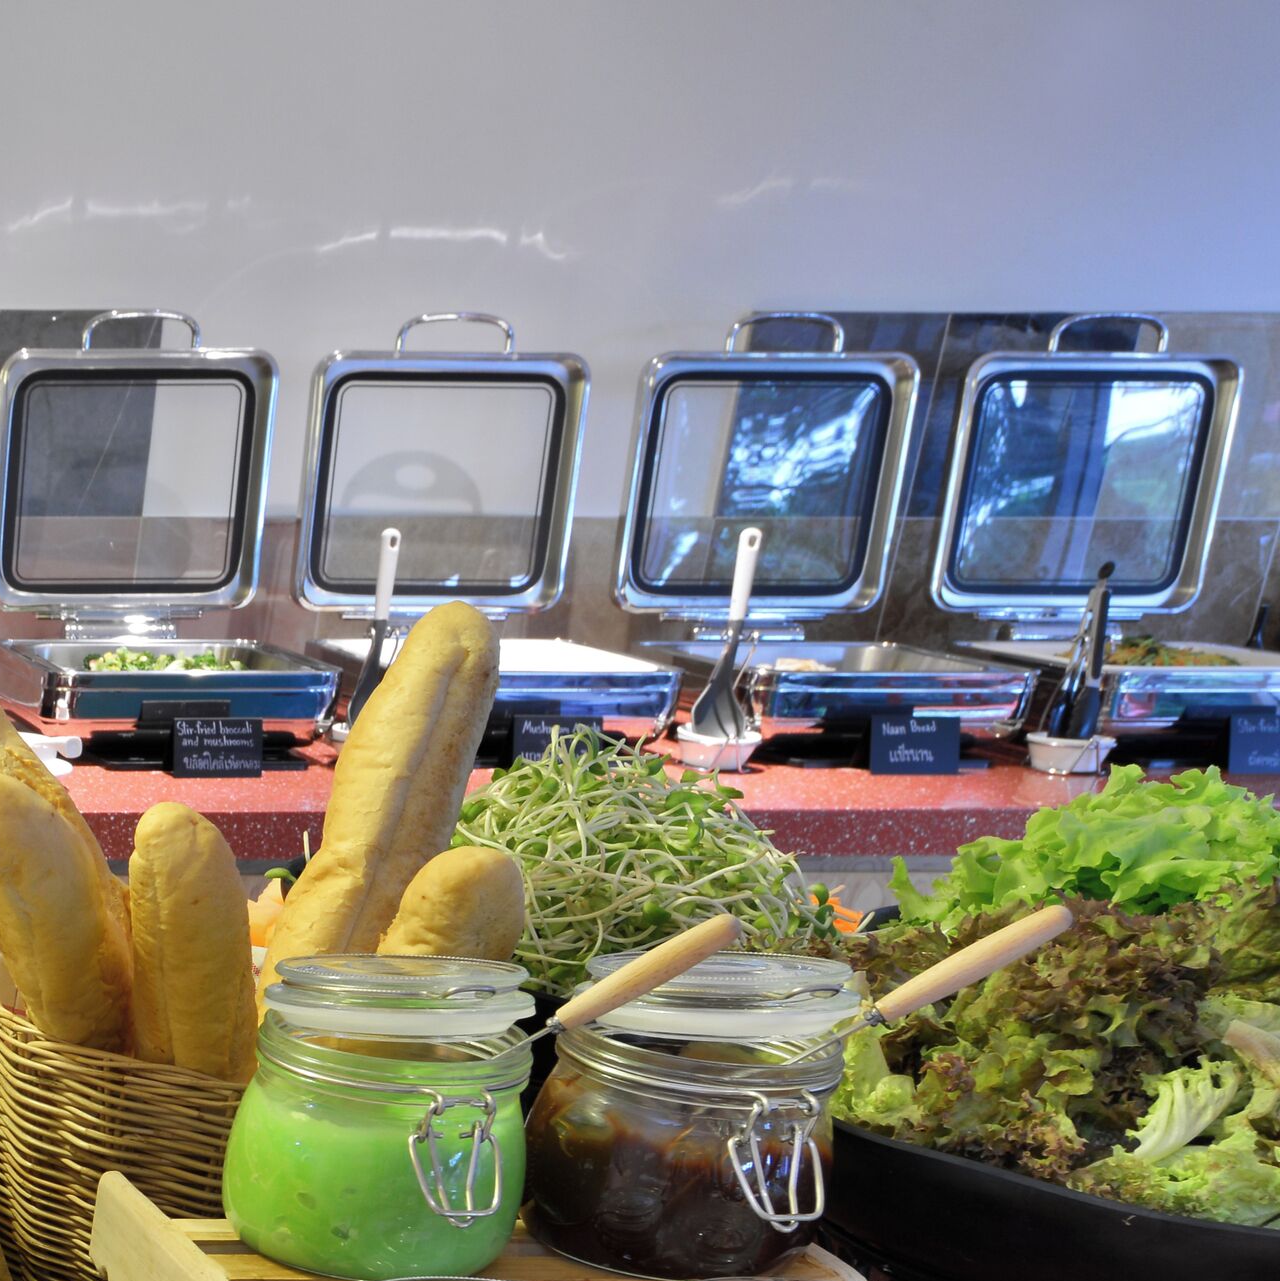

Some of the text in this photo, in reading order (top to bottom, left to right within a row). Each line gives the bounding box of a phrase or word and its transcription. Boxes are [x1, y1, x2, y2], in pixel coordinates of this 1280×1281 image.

[882, 719, 937, 737] Naan Bread
[182, 736, 199, 747] and
